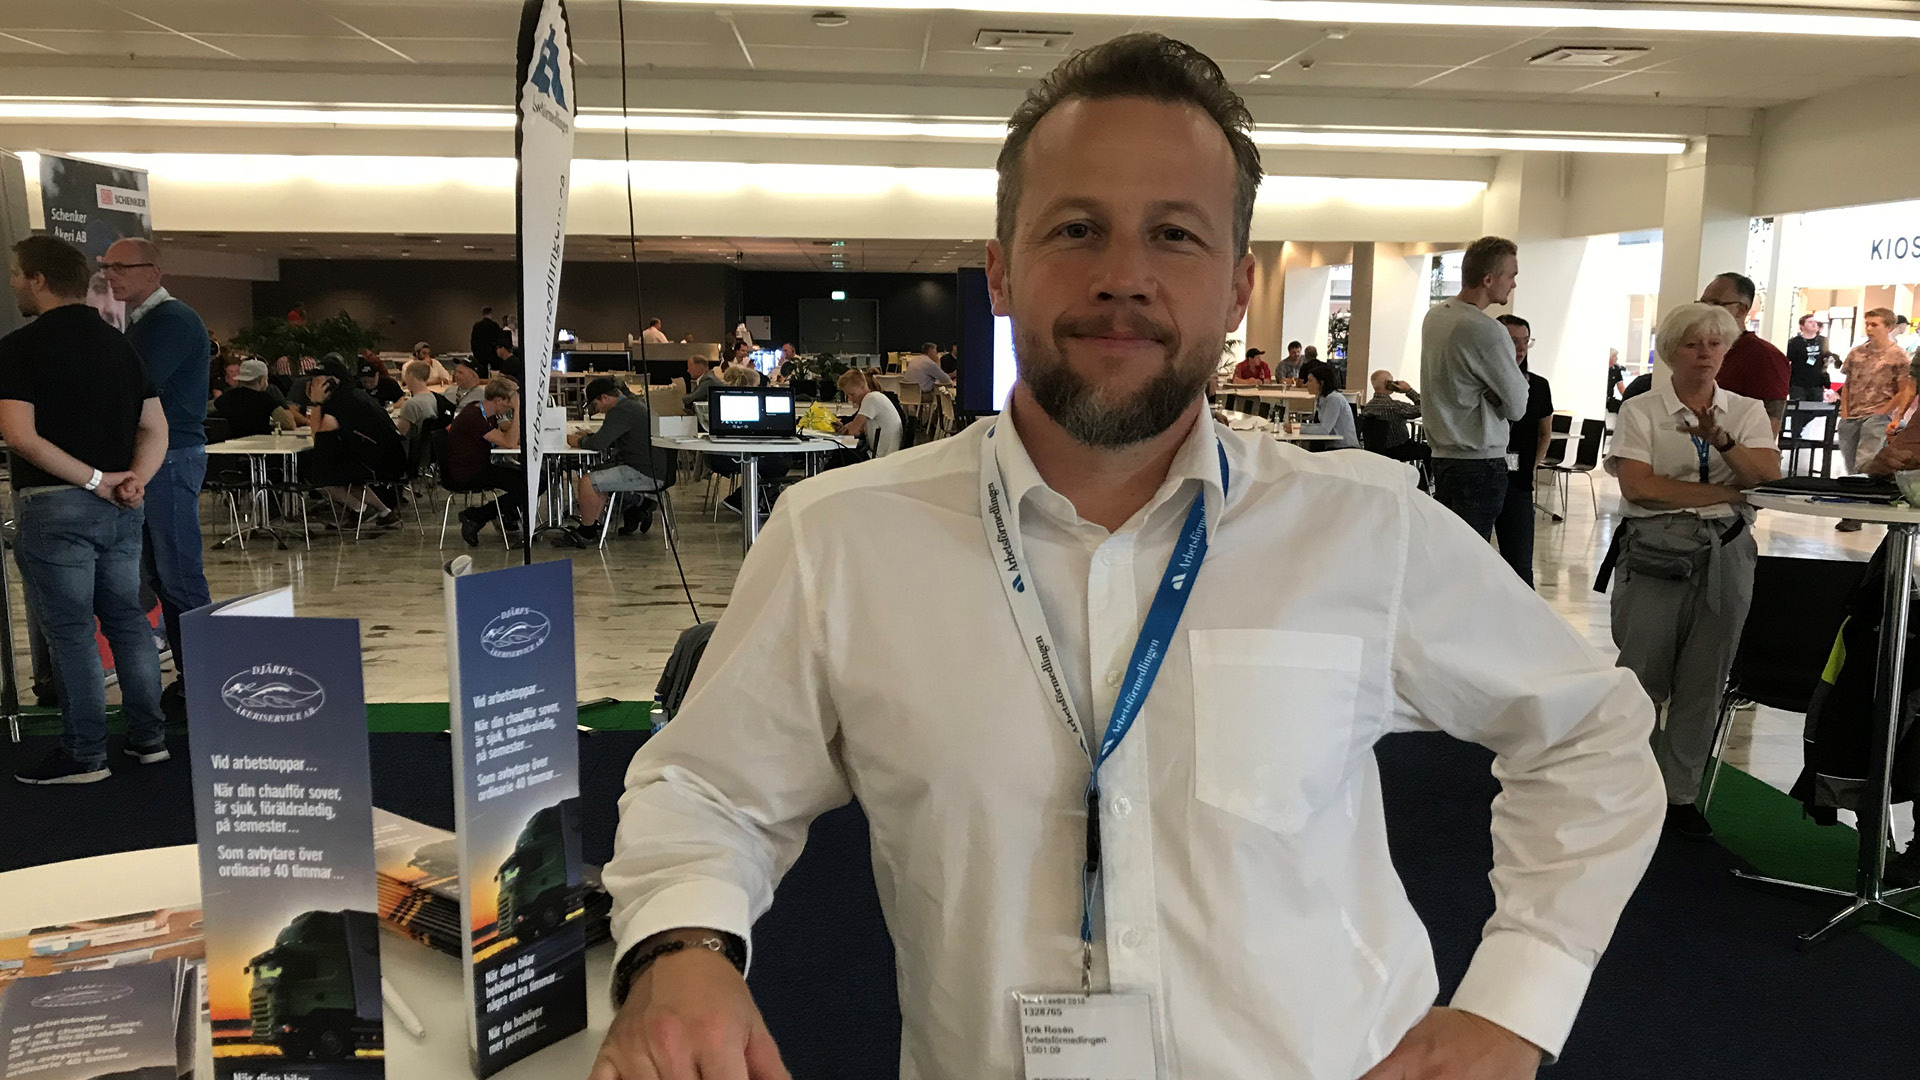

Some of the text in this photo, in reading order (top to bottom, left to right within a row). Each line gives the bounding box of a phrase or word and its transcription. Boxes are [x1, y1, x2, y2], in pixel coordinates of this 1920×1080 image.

[115, 194, 146, 208] SCHENKER
[51, 207, 87, 223] Schenker
[76, 230, 87, 243] AB
[1871, 236, 1920, 260] KIOS
[988, 482, 1019, 572] Arbetsförmedlingen
[252, 663, 294, 675] DJÄRFS
[1035, 635, 1080, 733] Arbetsförmedlingen
[1112, 639, 1160, 736] Arbetsförmedlingen
[473, 694, 486, 709] Vid
[233, 705, 316, 723] ÅKERISERVICE AB
[474, 719, 489, 732] När
[491, 716, 504, 729] din
[505, 707, 537, 725] chaufför
[475, 735, 484, 748] är
[211, 754, 229, 769] Vid
[476, 748, 487, 766] på
[477, 757, 549, 786] Som avbytare över
[213, 783, 342, 801] När din chaufför sover,
[478, 781, 514, 801] ordinarie
[515, 776, 526, 789] 40
[214, 802, 336, 820] är sjuk, föräldraledig,
[216, 817, 231, 835] på
[217, 845, 323, 863] Som avbytare över
[219, 863, 270, 877] ordinarie
[274, 864, 288, 878] 40
[485, 954, 535, 985] När dina bilar
[486, 968, 535, 999] behöver rulla
[487, 994, 508, 1013] några
[508, 985, 528, 1002] extra
[488, 1006, 544, 1041] När du behöver
[1024, 1025, 1074, 1034] Erik Rosén
[489, 1040, 504, 1056] mer
[1025, 1035, 1107, 1046] Arbetsförmedlingen
